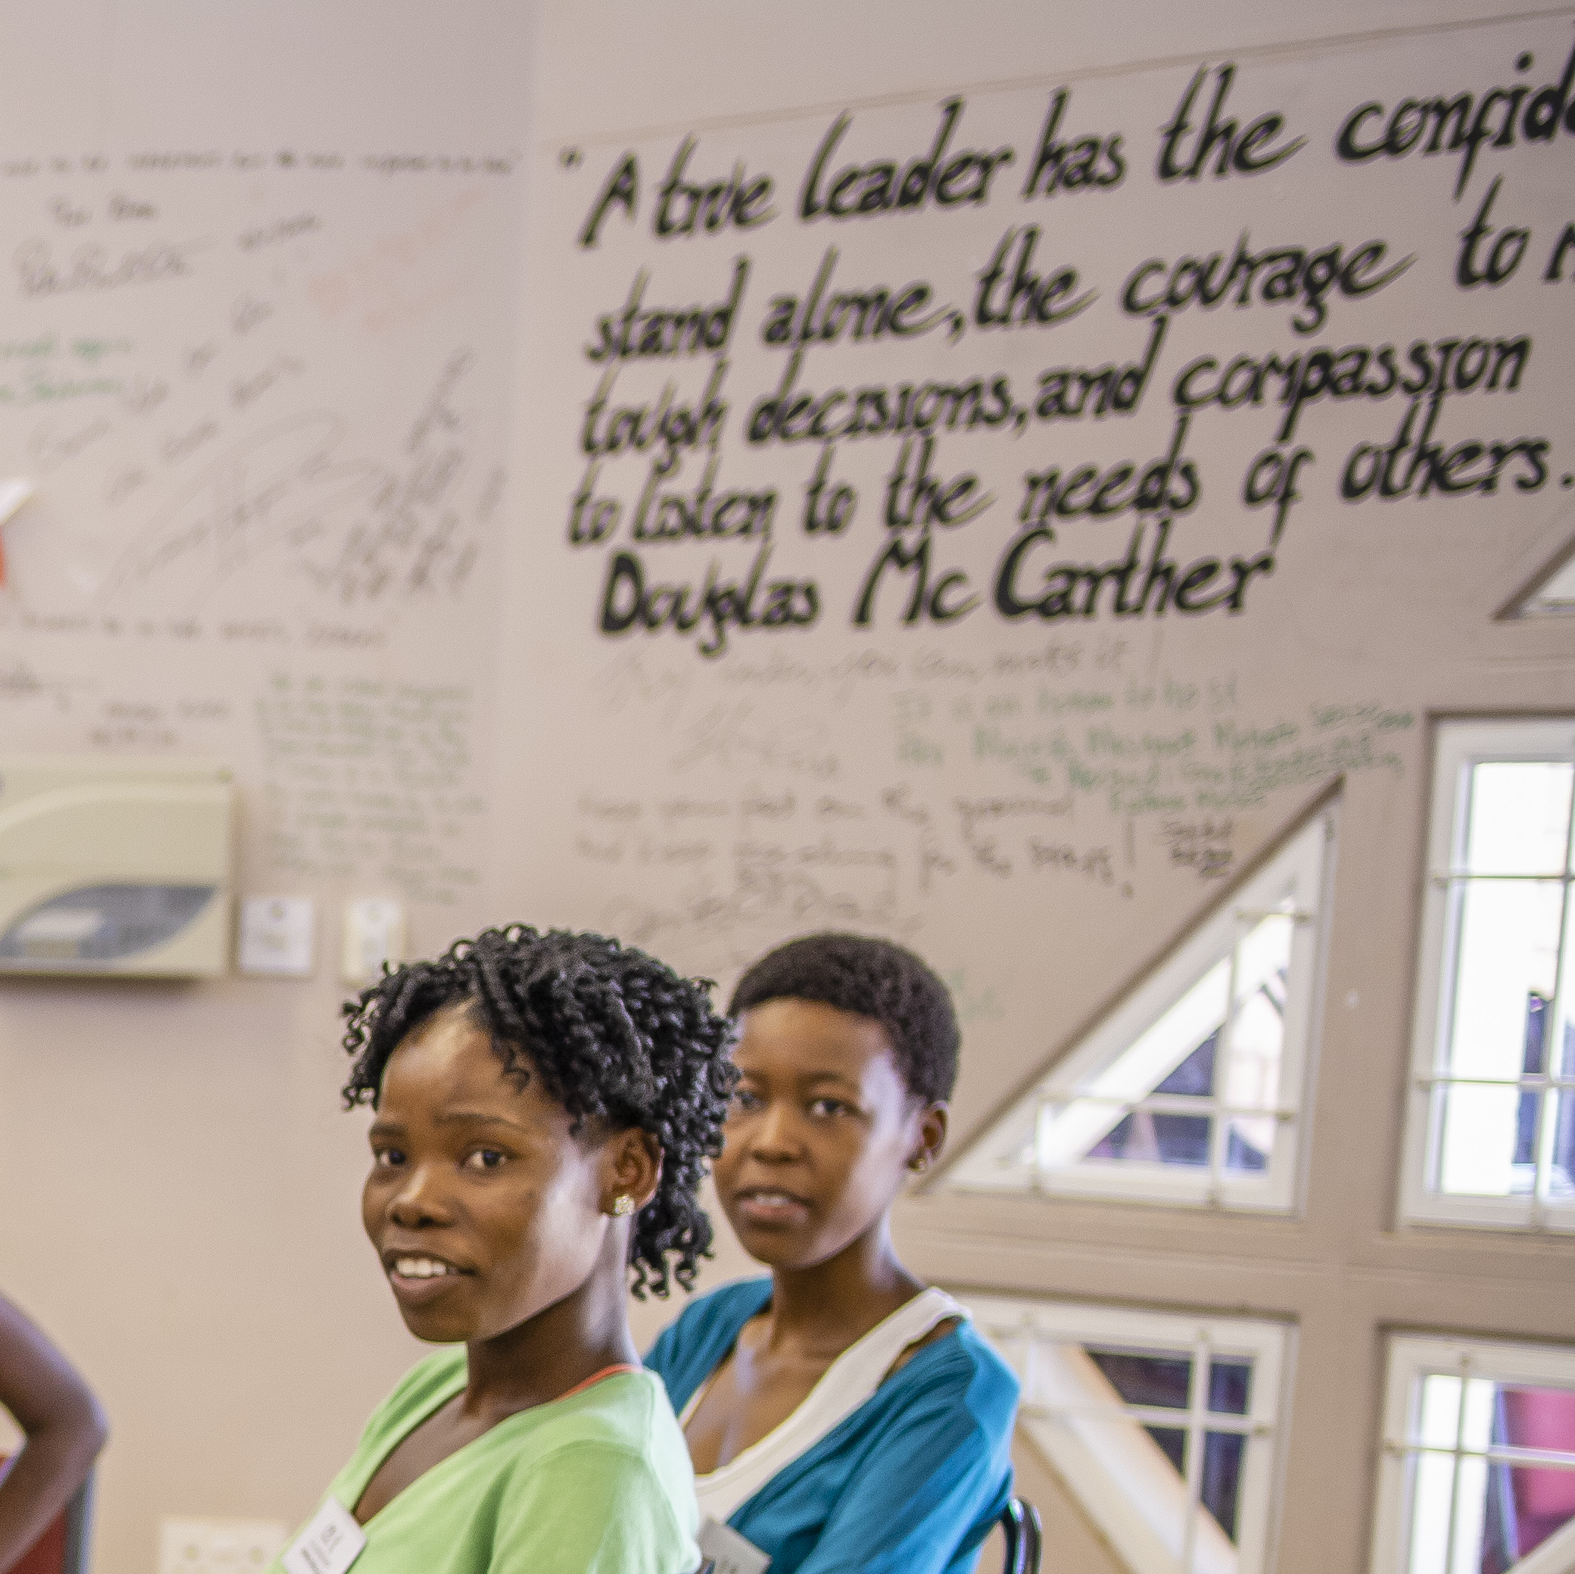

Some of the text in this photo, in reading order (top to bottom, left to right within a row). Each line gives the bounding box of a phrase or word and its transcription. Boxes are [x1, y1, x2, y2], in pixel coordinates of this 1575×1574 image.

[798, 95, 1014, 223] leader
[1019, 85, 1127, 200] has
[1156, 60, 1308, 183] the
[584, 252, 753, 362] stand
[973, 222, 1099, 328] the
[1121, 230, 1418, 338] courage
[1457, 172, 1531, 290] to
[570, 395, 1575, 550] to listen to the needs of others.
[581, 355, 728, 475] tough
[1034, 310, 1169, 420] and
[601, 540, 821, 656] Douglas
[854, 530, 981, 627] Mc
